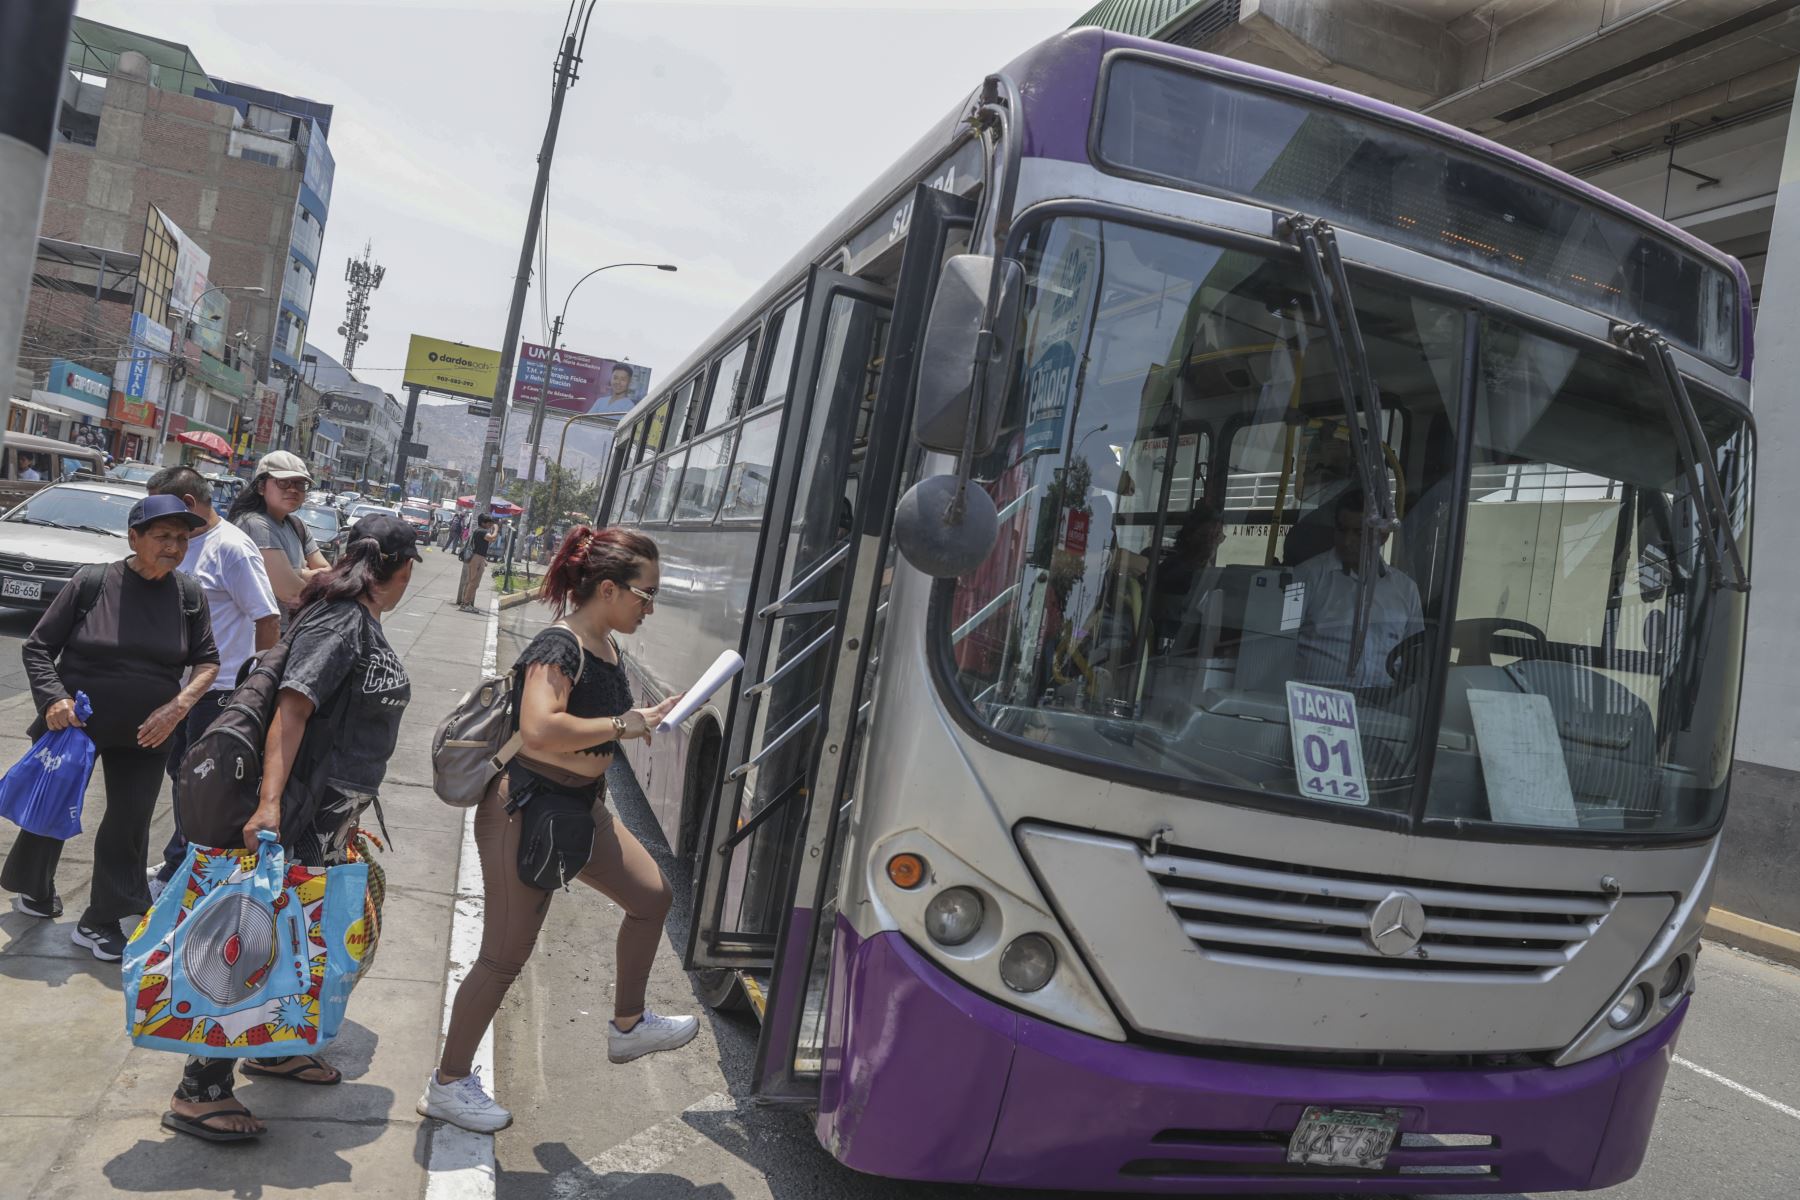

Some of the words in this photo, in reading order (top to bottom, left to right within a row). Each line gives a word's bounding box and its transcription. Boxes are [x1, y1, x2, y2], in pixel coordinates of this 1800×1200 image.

[528, 346, 561, 363] UMA
[131, 350, 146, 396] DENTAL
[1293, 690, 1351, 723] TACNA
[1303, 734, 1352, 777] 01
[1307, 776, 1361, 798] 412
